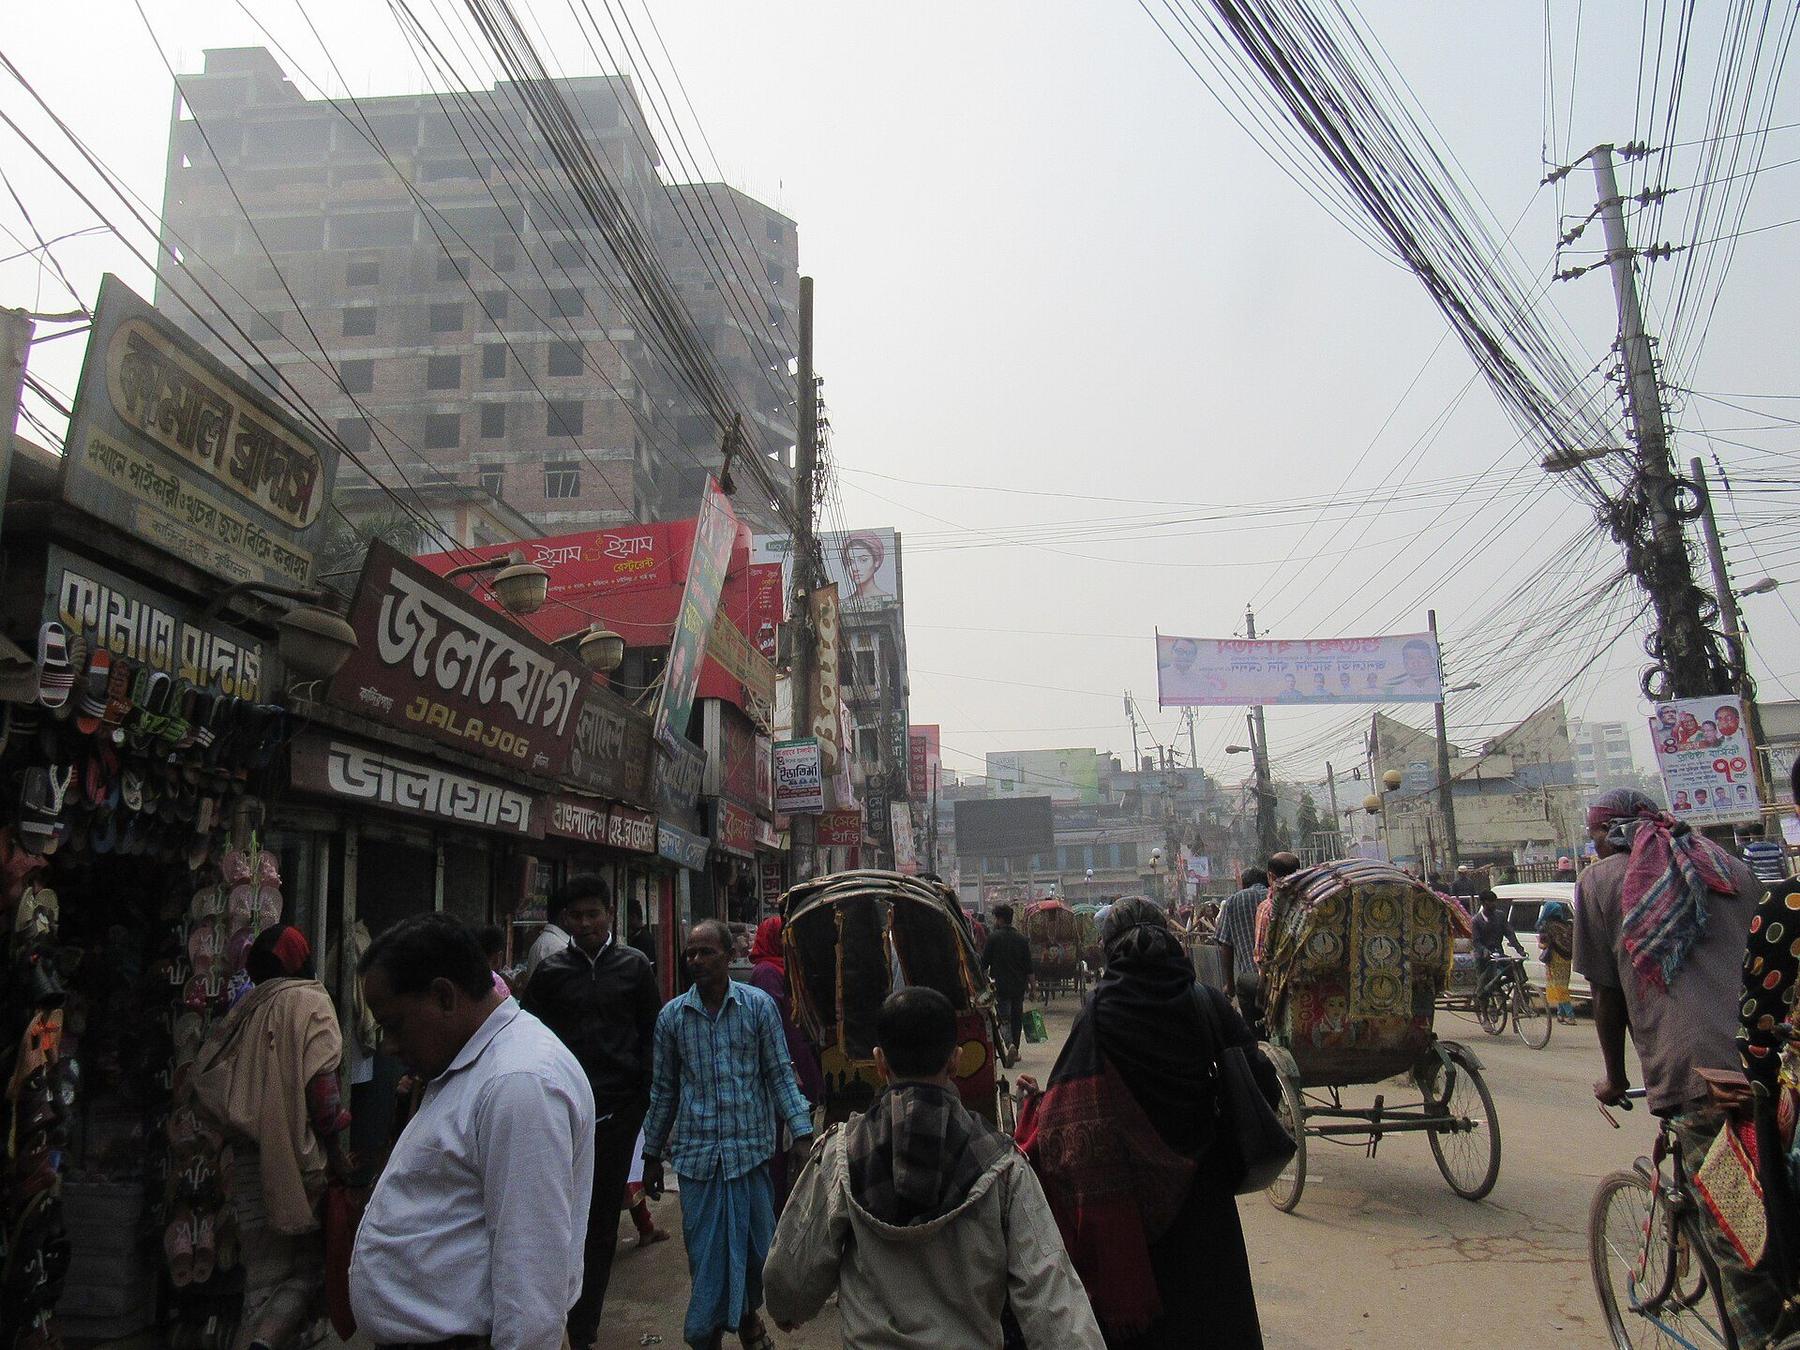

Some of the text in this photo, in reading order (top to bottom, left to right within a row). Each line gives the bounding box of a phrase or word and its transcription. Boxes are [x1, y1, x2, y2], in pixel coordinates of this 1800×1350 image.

[532, 534, 654, 569] ইয়াম ইয়াম
[59, 570, 175, 674] কামাল
[378, 567, 581, 737] জলযোগ
[812, 595, 838, 766] Bata
[405, 695, 529, 759] JALAJOG
[328, 741, 534, 832] জলযোগ
[1713, 756, 1747, 783] ৭০
[551, 800, 607, 841] বাংলাদেশ
